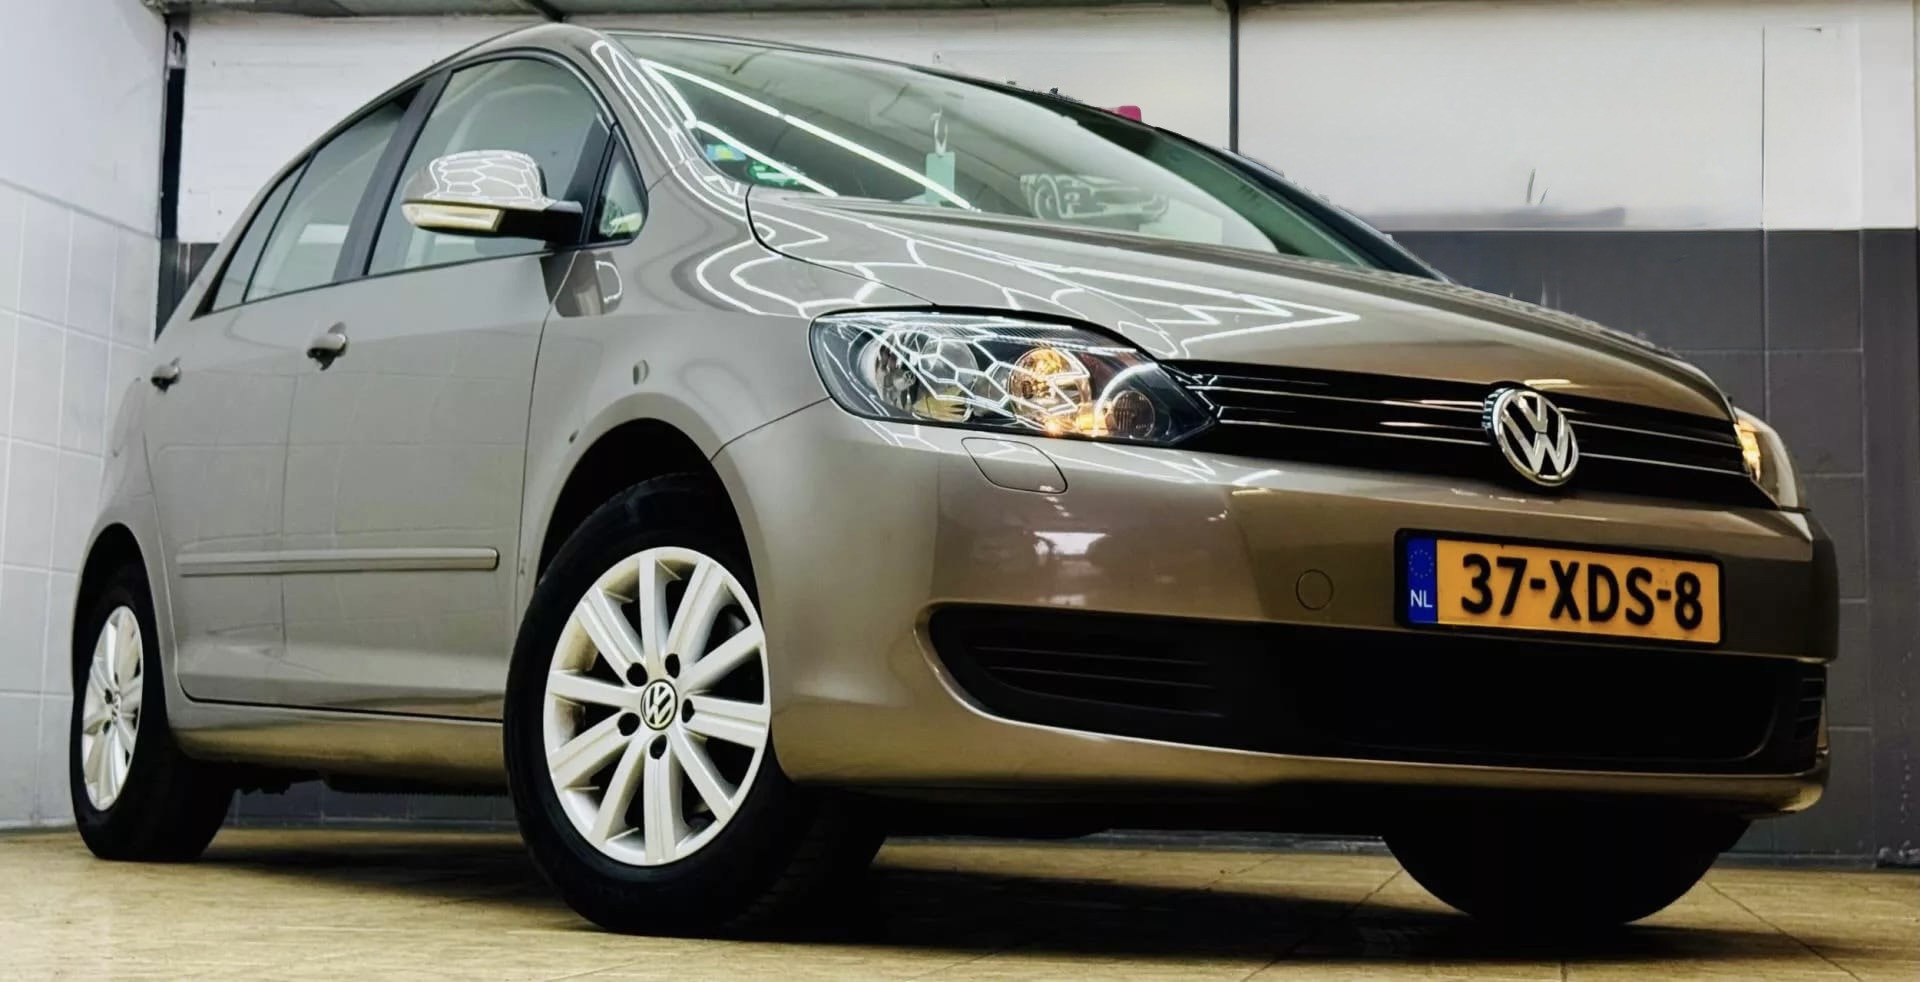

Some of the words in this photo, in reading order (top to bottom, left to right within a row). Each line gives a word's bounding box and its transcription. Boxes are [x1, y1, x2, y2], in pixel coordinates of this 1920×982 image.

[1500, 389, 1572, 477] VW
[1410, 589, 1433, 608] NL
[1461, 553, 1703, 630] 37-XDS-8
[643, 682, 674, 727] VW
